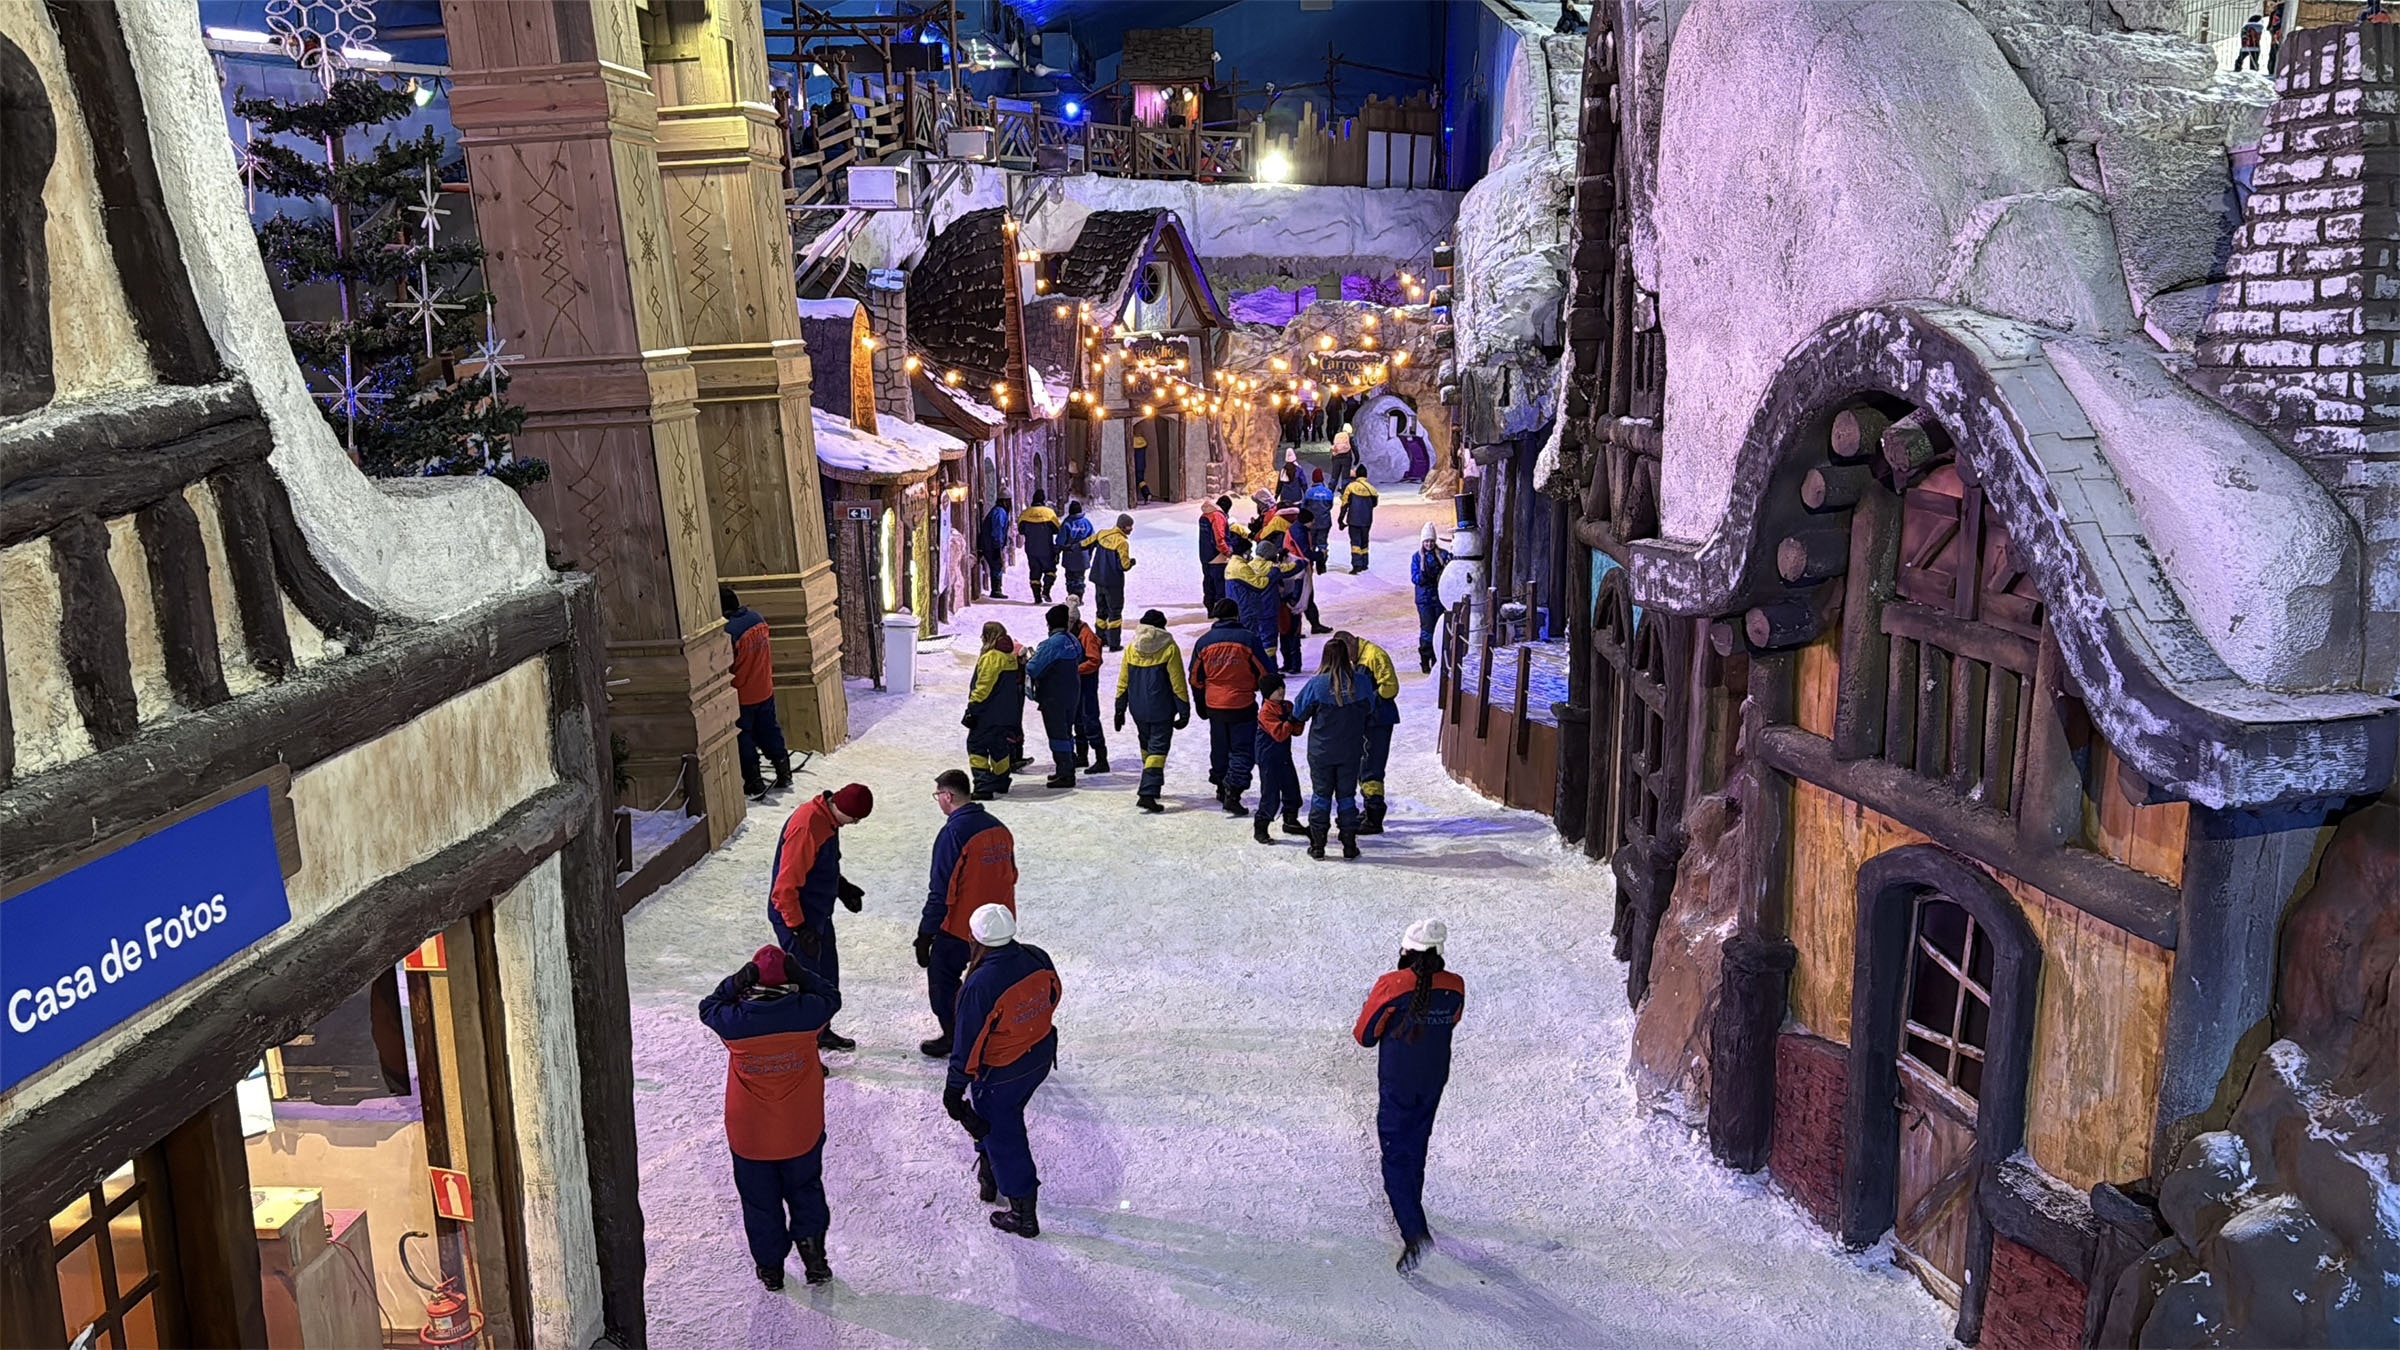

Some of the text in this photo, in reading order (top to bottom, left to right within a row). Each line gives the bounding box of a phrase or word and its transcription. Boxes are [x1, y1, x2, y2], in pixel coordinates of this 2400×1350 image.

[1340, 370, 1378, 386] Nve
[8, 893, 227, 1034] Casa de Fotos
